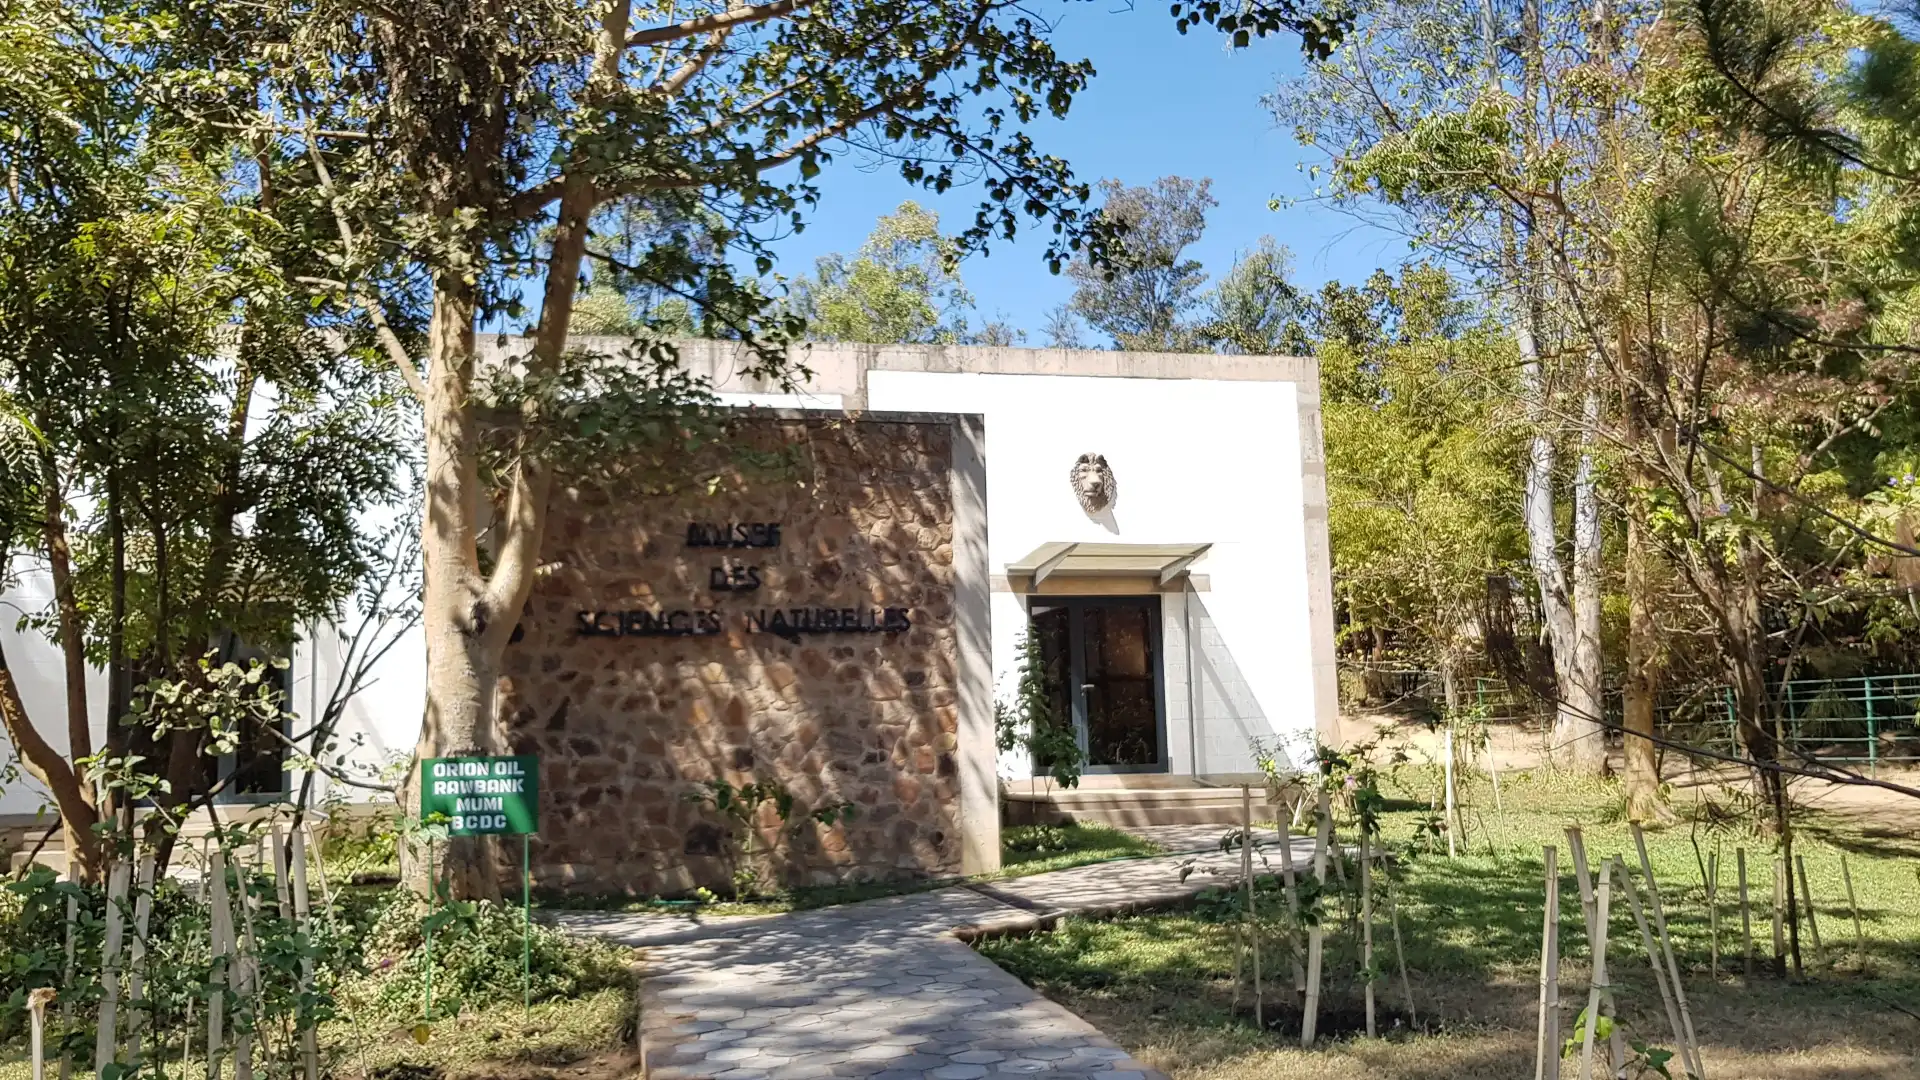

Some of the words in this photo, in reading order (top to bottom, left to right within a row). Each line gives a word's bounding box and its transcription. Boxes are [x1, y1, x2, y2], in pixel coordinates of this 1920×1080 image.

[710, 566, 760, 590] DES
[577, 610, 721, 634] SCIENCES
[745, 608, 911, 633] NATURELLES
[433, 762, 490, 777] ORION
[494, 761, 525, 776] OIL
[433, 778, 525, 795] RAWBANK
[456, 797, 503, 812] MUMI
[451, 814, 507, 830] BCDC
